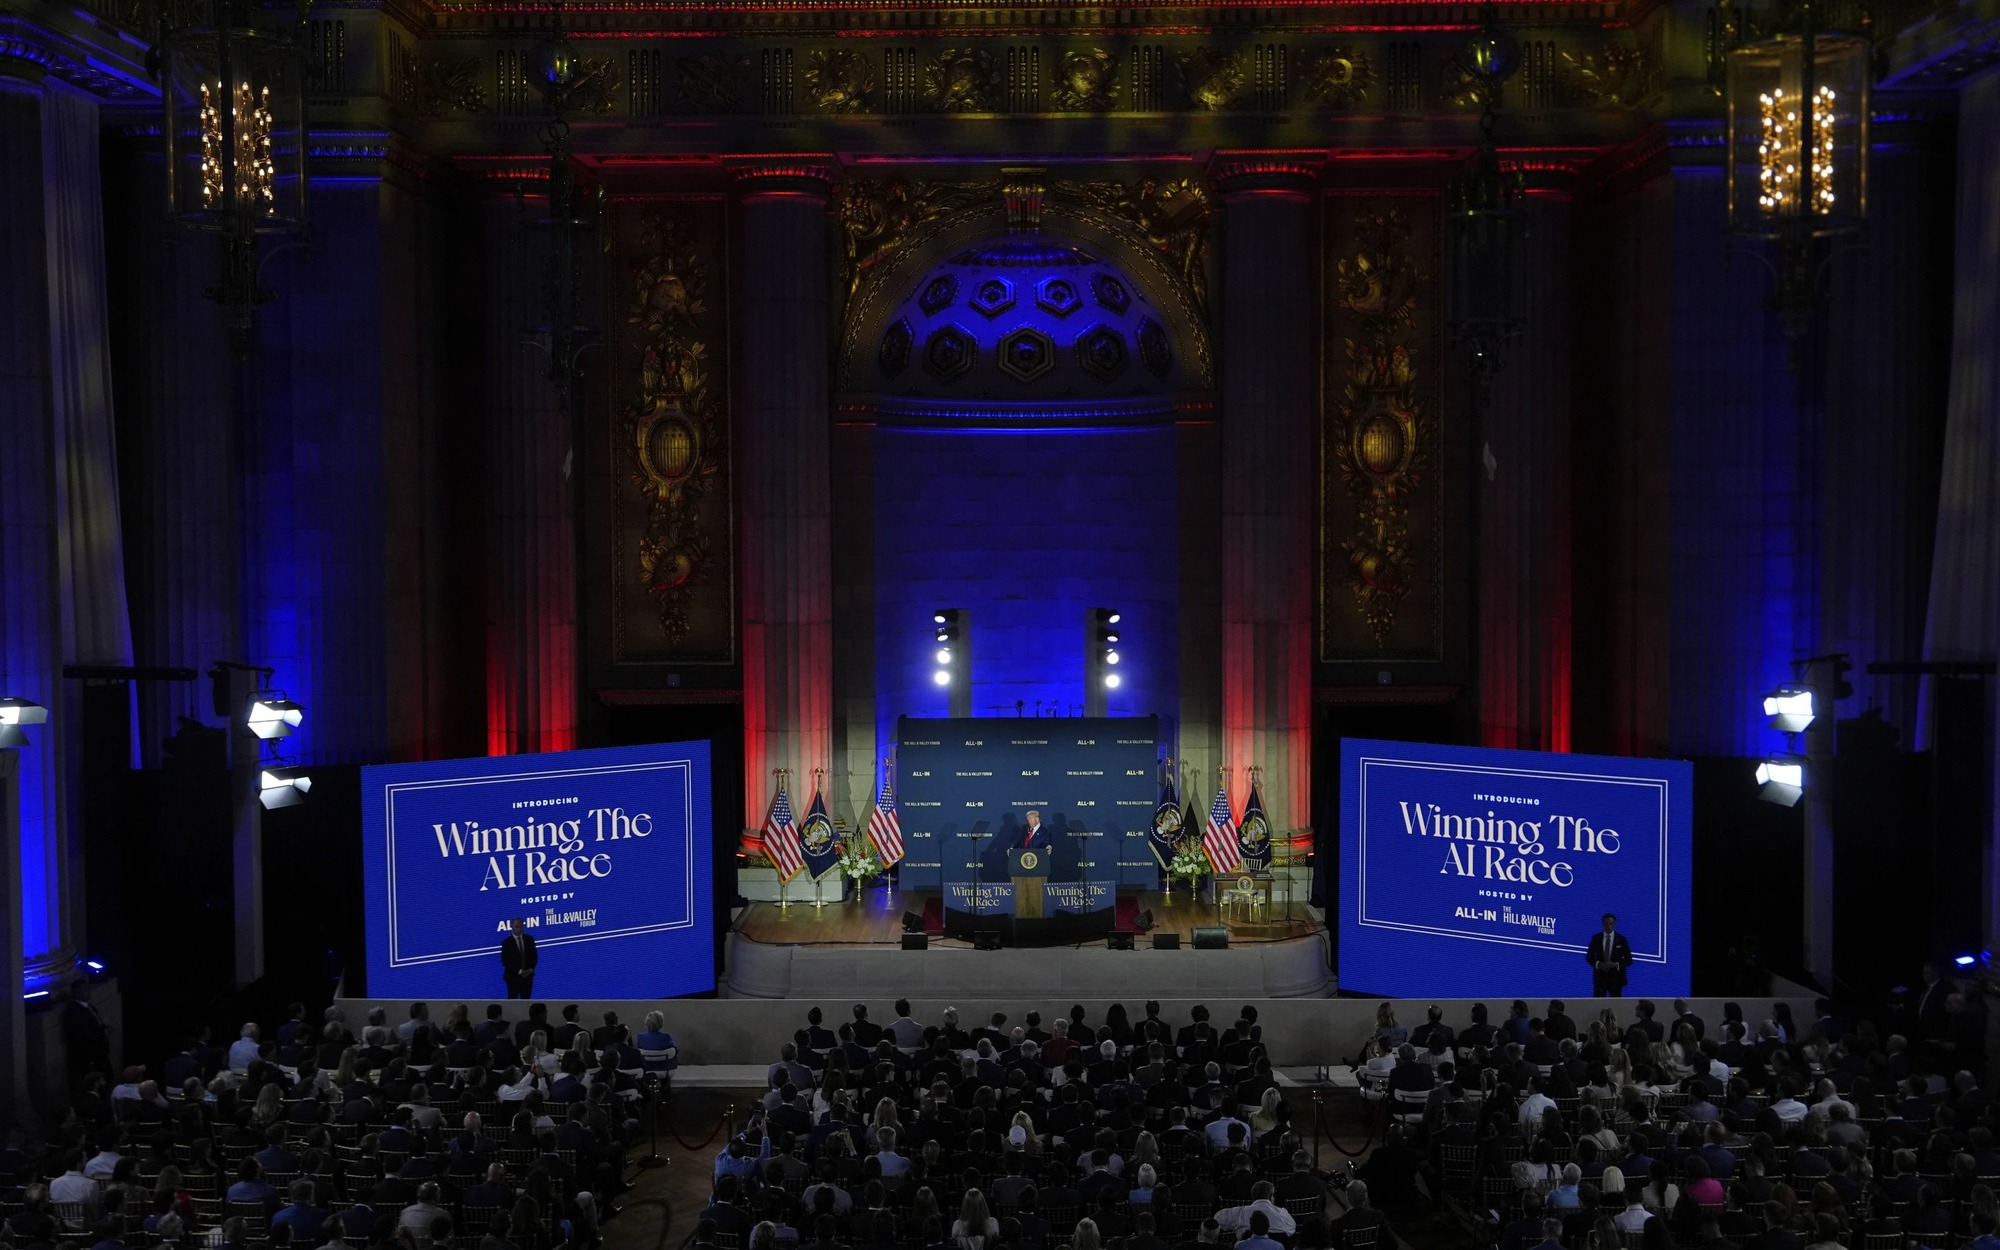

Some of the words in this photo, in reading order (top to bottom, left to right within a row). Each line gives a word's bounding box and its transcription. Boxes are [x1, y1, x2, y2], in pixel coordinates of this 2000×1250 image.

[512, 797, 579, 809] INTRODUCING
[1473, 794, 1540, 805] INTRODUCING
[432, 816, 584, 858] Winning
[588, 807, 653, 842] The
[1399, 801, 1545, 855] Winning
[1549, 815, 1620, 854] The
[1440, 842, 1476, 877] AI
[1484, 845, 1574, 887] Race
[479, 854, 517, 891] AI
[525, 851, 612, 887] Race
[993, 886, 1012, 896] The
[1087, 886, 1107, 895] The
[1479, 890, 1516, 900] HOSTED
[521, 894, 558, 904] HOSTED
[963, 897, 974, 906] AI
[976, 897, 1000, 906] Race
[1059, 897, 1069, 906] AI
[1455, 907, 1497, 921] ALL-IN
[1503, 905, 1512, 913] THE
[497, 916, 540, 932] AL-IN
[1538, 926, 1555, 935] FORUM
